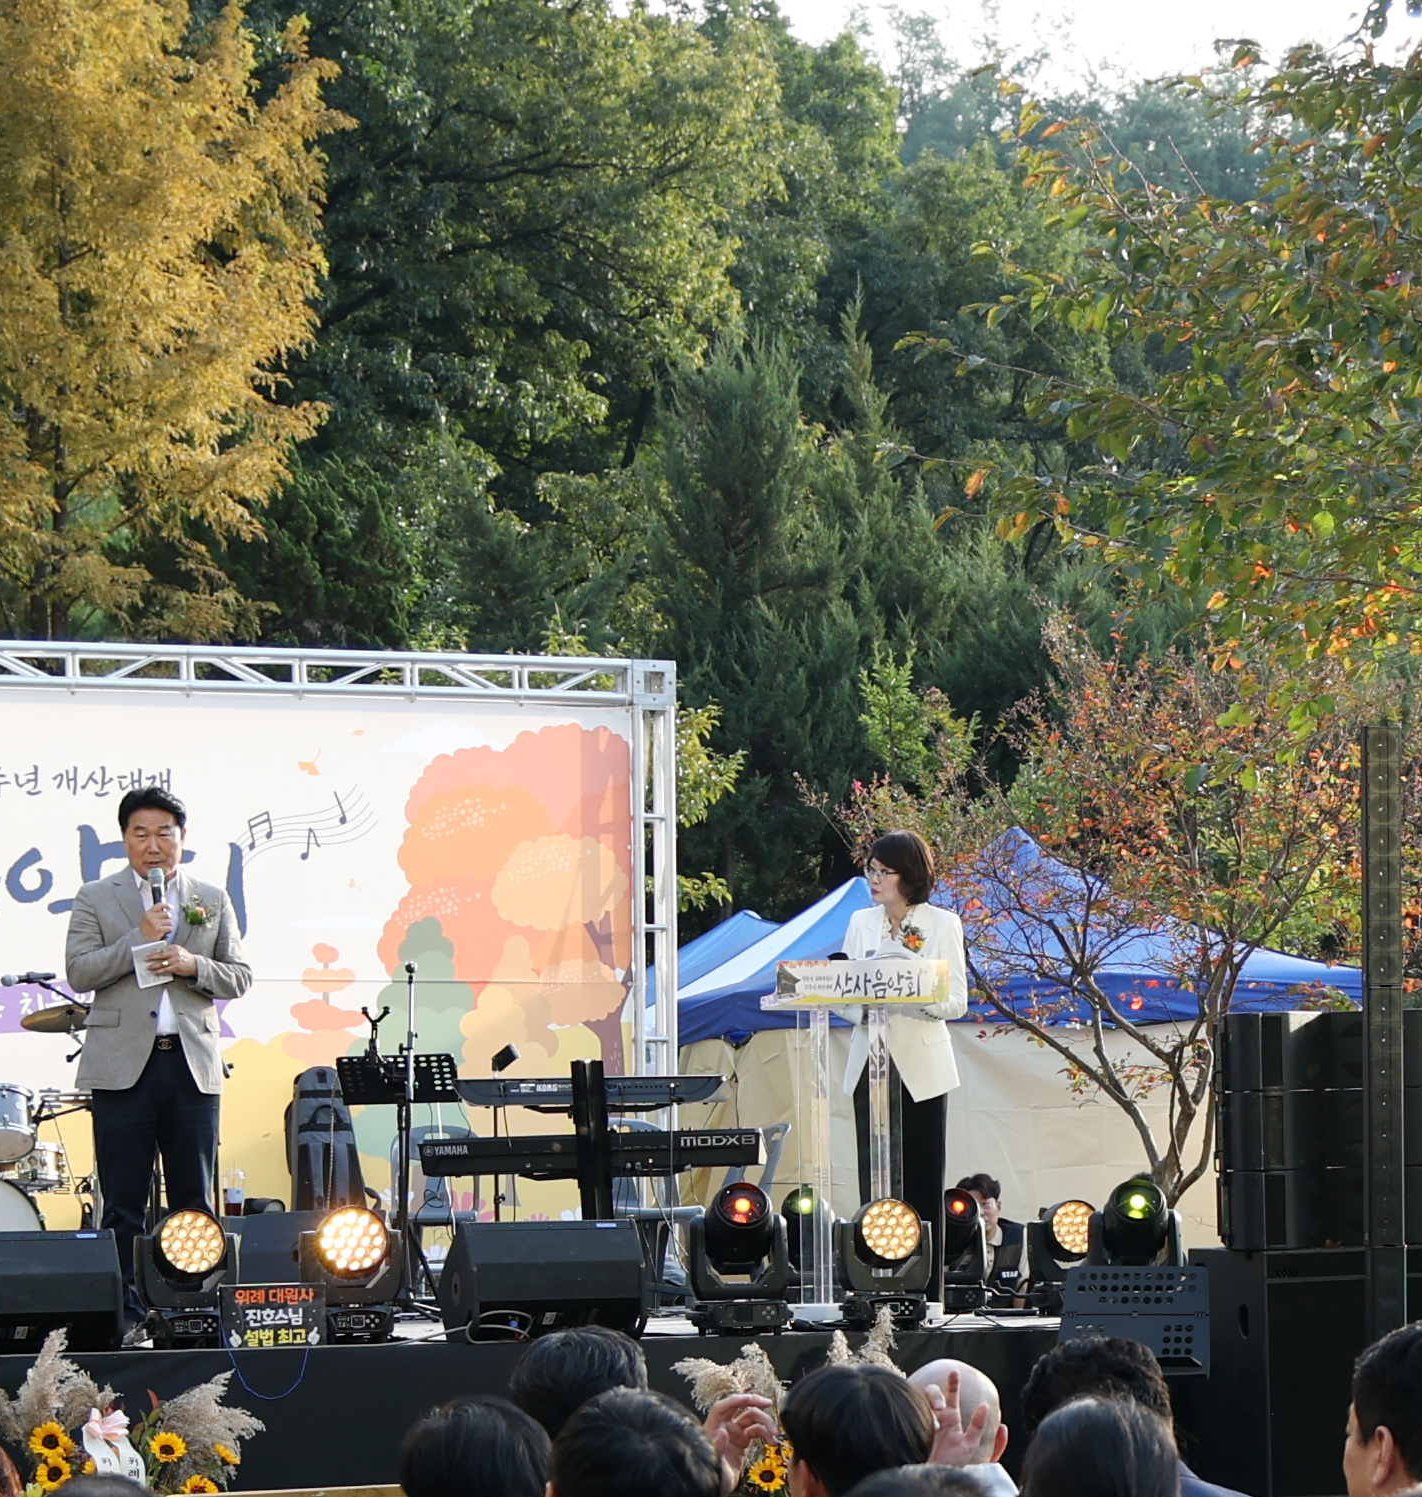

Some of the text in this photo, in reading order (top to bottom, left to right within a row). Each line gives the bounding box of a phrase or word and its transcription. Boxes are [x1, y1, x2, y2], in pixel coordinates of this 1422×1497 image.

[834, 968, 921, 1000] 산사음악회
[680, 1135, 756, 1147] MODX8
[434, 1145, 469, 1156] YAMAHA
[242, 1287, 315, 1305] 위례 대원사
[245, 1307, 303, 1327] 진호스님
[244, 1328, 307, 1347] 설법 최고
